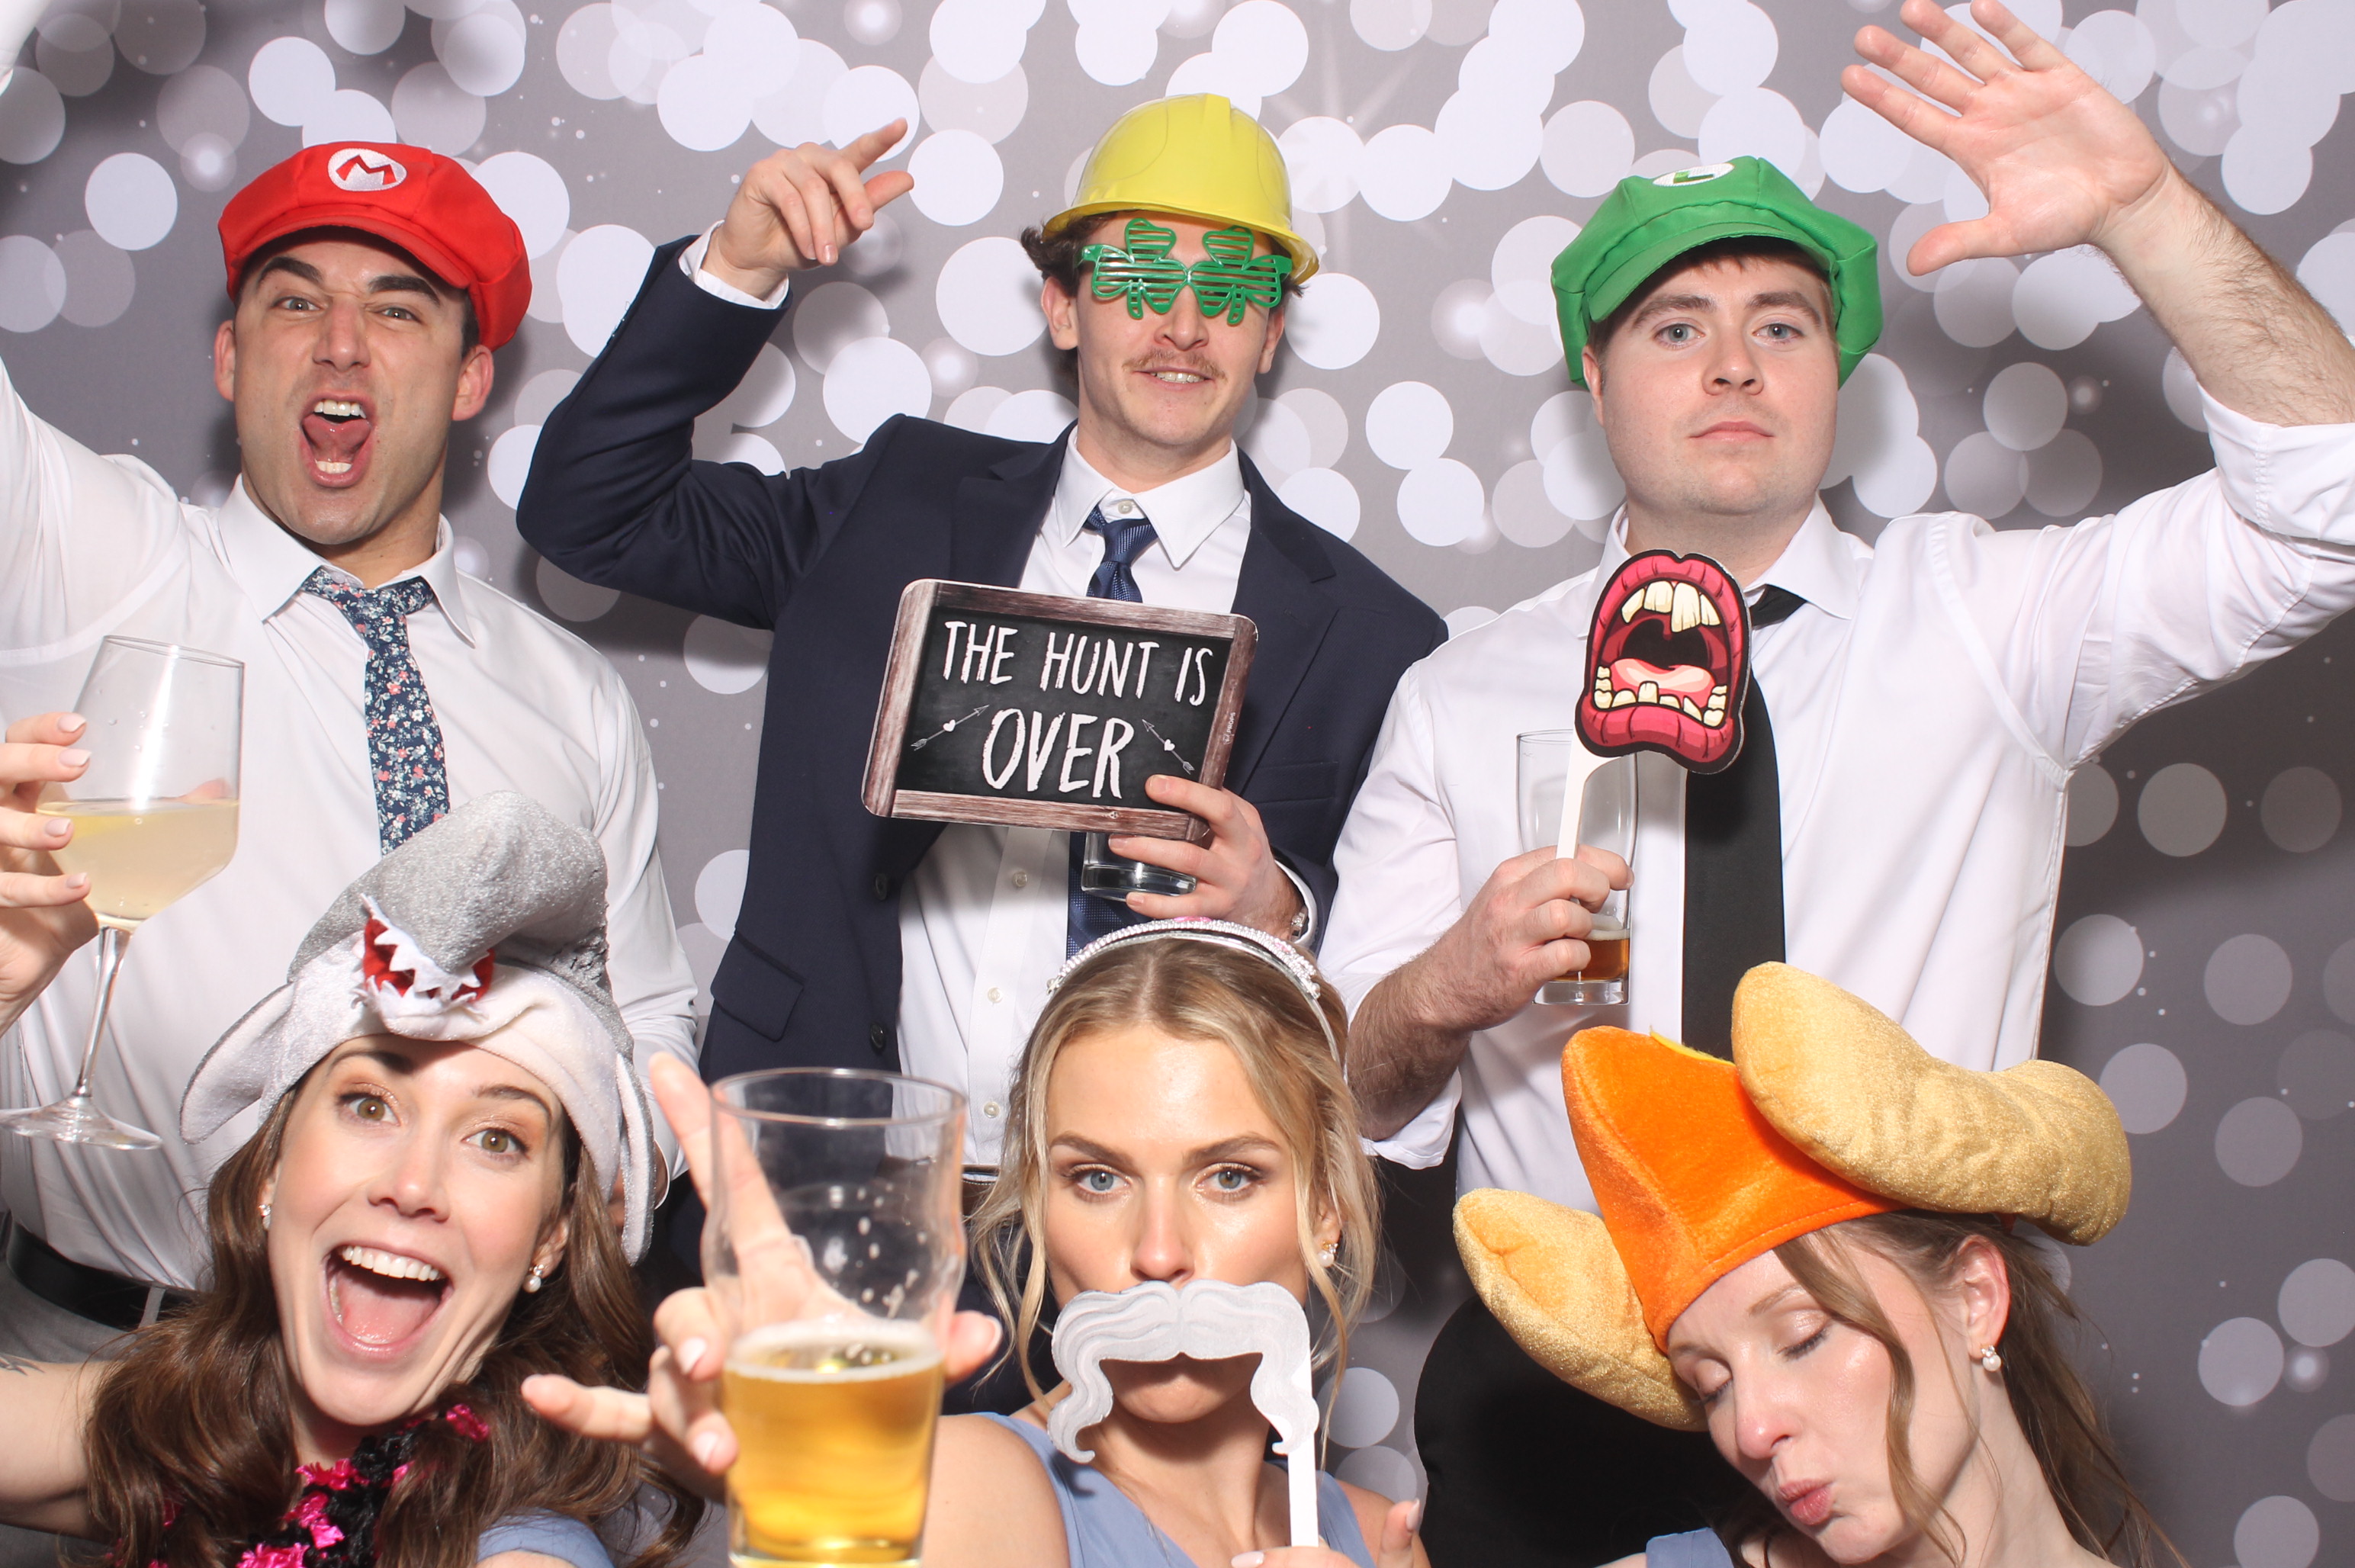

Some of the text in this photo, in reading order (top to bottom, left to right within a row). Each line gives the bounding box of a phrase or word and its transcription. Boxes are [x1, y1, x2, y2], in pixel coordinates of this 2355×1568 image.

[336, 154, 397, 185] M
[943, 622, 1213, 705] THE HUNT IS
[1226, 712, 1236, 733] PROPS
[982, 708, 1135, 799] OVER
